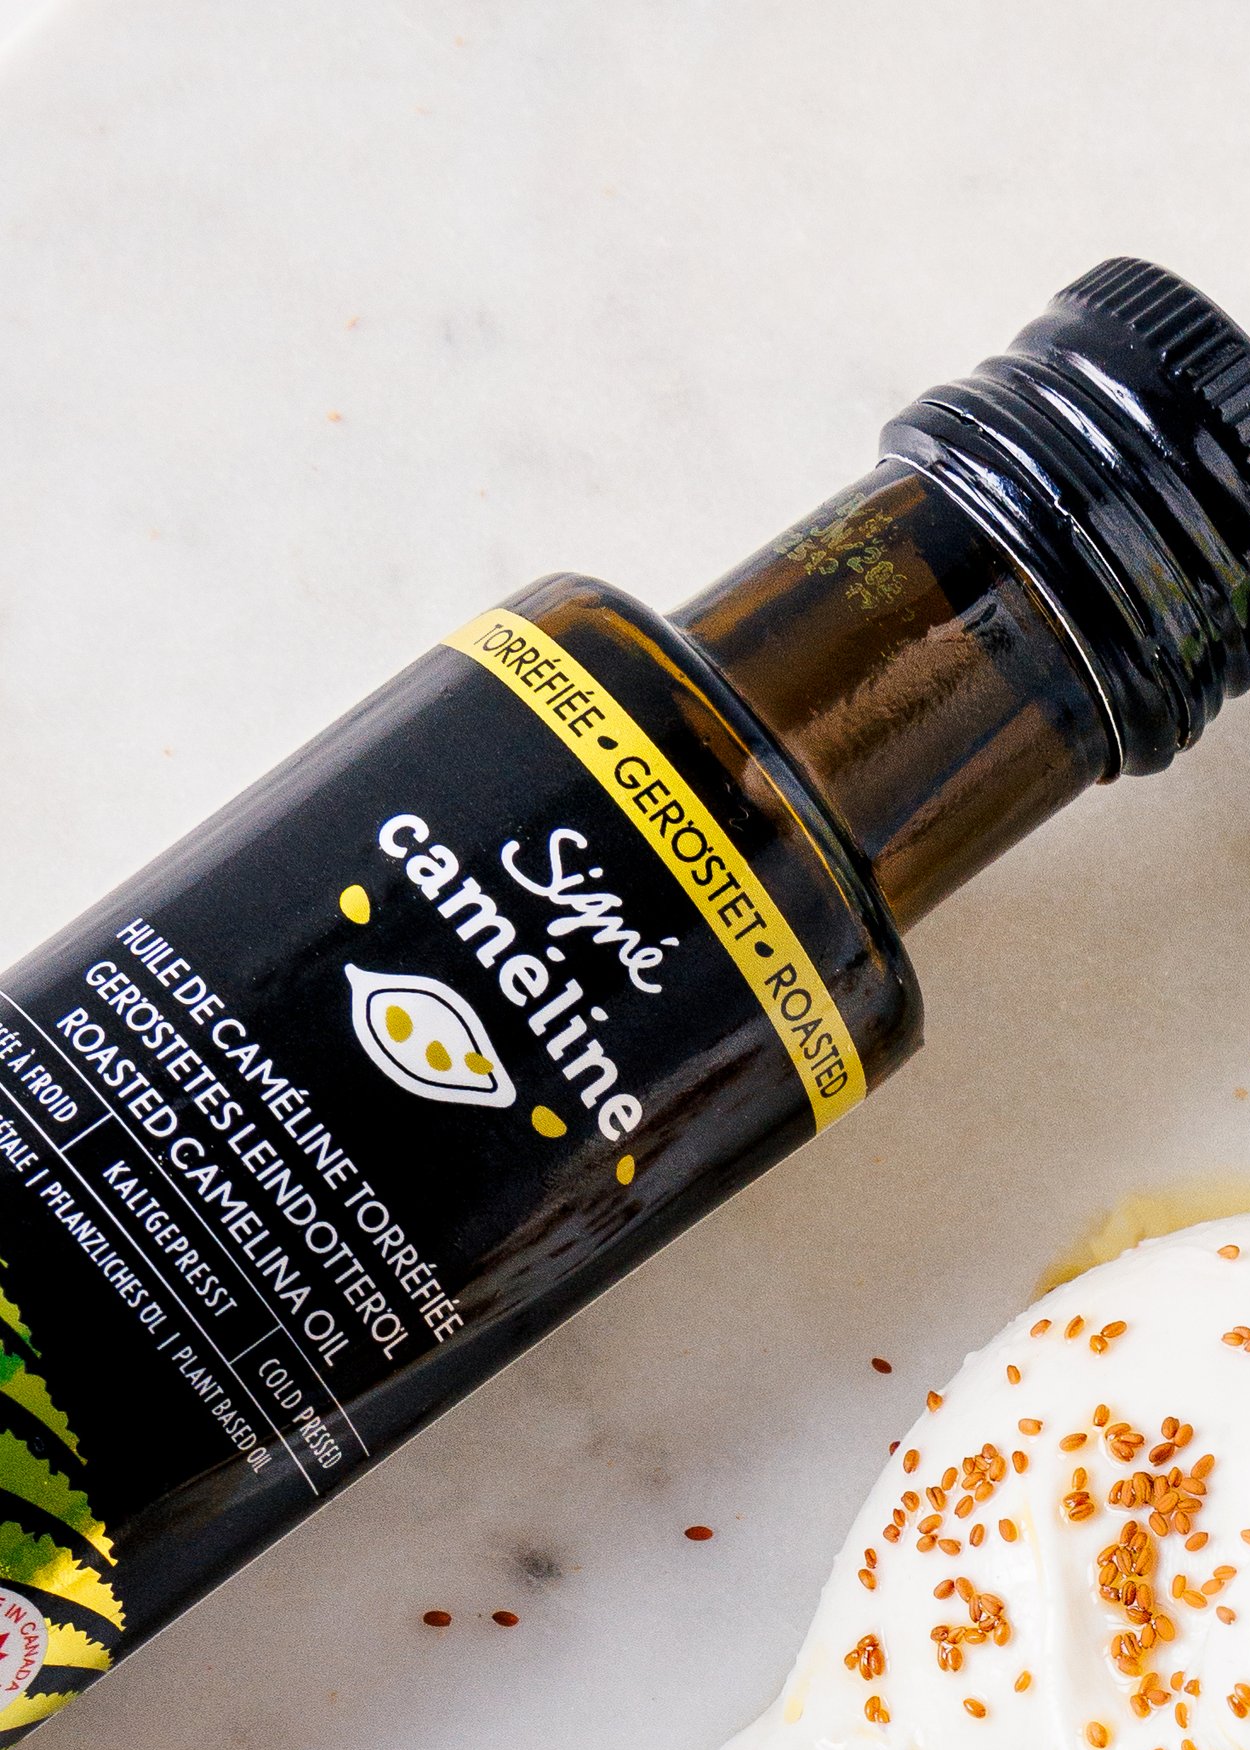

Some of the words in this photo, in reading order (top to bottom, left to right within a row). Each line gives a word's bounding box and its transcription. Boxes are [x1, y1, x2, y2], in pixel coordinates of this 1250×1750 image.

[473, 621, 607, 739] TORRÉFIÉE
[613, 755, 768, 942] GERÖSTET
[764, 963, 850, 1099] ROASTED
[501, 828, 681, 994] Signé
[378, 813, 643, 1143] caméline
[21, 1064, 79, 1123] FROID
[56, 1007, 179, 1138] ROASTED
[170, 1137, 312, 1316] CAMELINA
[303, 1307, 351, 1368] OIL
[85, 960, 244, 1132] GERÖSTETES
[227, 1123, 411, 1361] LEINDOTTERÖL
[115, 917, 193, 988] HUILE
[171, 973, 226, 1027] DE
[211, 1017, 360, 1191] CAMÉLINE
[344, 1181, 466, 1343] TORRÉFIÉE
[40, 1181, 150, 1309] PFLANZLICHES
[171, 1345, 225, 1404] PLANT
[210, 1398, 258, 1458] BASED
[245, 1447, 273, 1474] OIL
[102, 1160, 238, 1318] KALTGEPRESST
[257, 1357, 302, 1410] COLD
[291, 1405, 342, 1470] PRESSED
[5, 1603, 27, 1624] IN
[5, 1621, 40, 1692] CANADA
